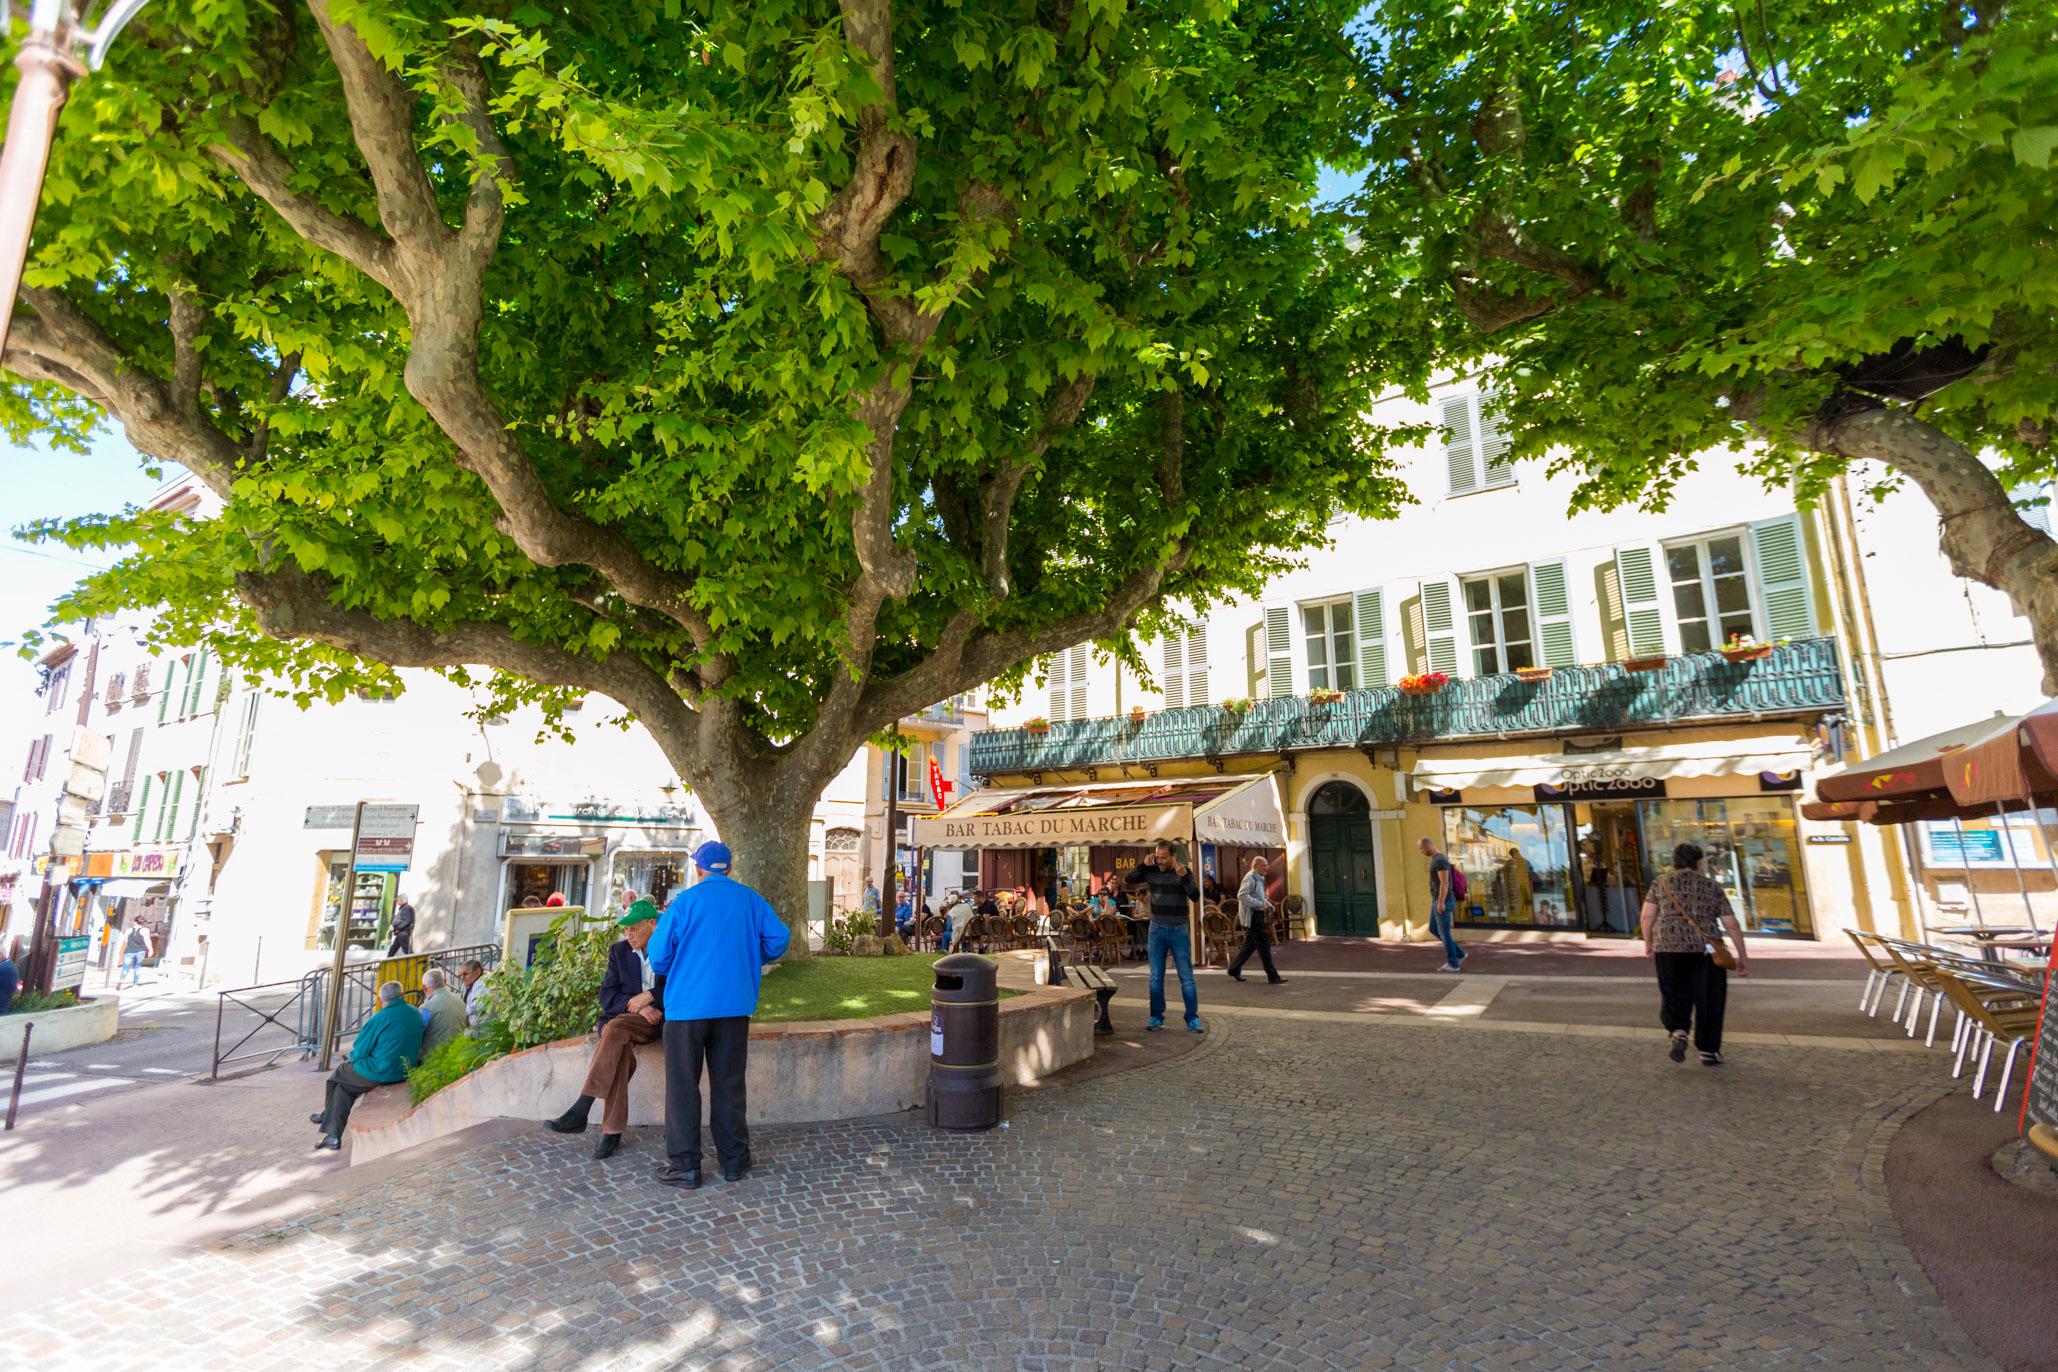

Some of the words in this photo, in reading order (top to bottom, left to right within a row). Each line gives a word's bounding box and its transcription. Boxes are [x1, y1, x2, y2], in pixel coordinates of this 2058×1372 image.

[932, 766, 943, 800] TABAC
[1561, 768, 1598, 783] Optic
[1599, 768, 1632, 779] 2000
[946, 823, 975, 837] BAR
[982, 820, 1035, 836] TABAC
[1040, 818, 1065, 834] DU
[1070, 815, 1148, 833] MARCHE
[1208, 816, 1220, 828] BAR
[1223, 818, 1242, 831] TABAC
[1244, 820, 1253, 832] DU
[1255, 821, 1277, 833] MARCHE
[1115, 857, 1136, 869] BAR
